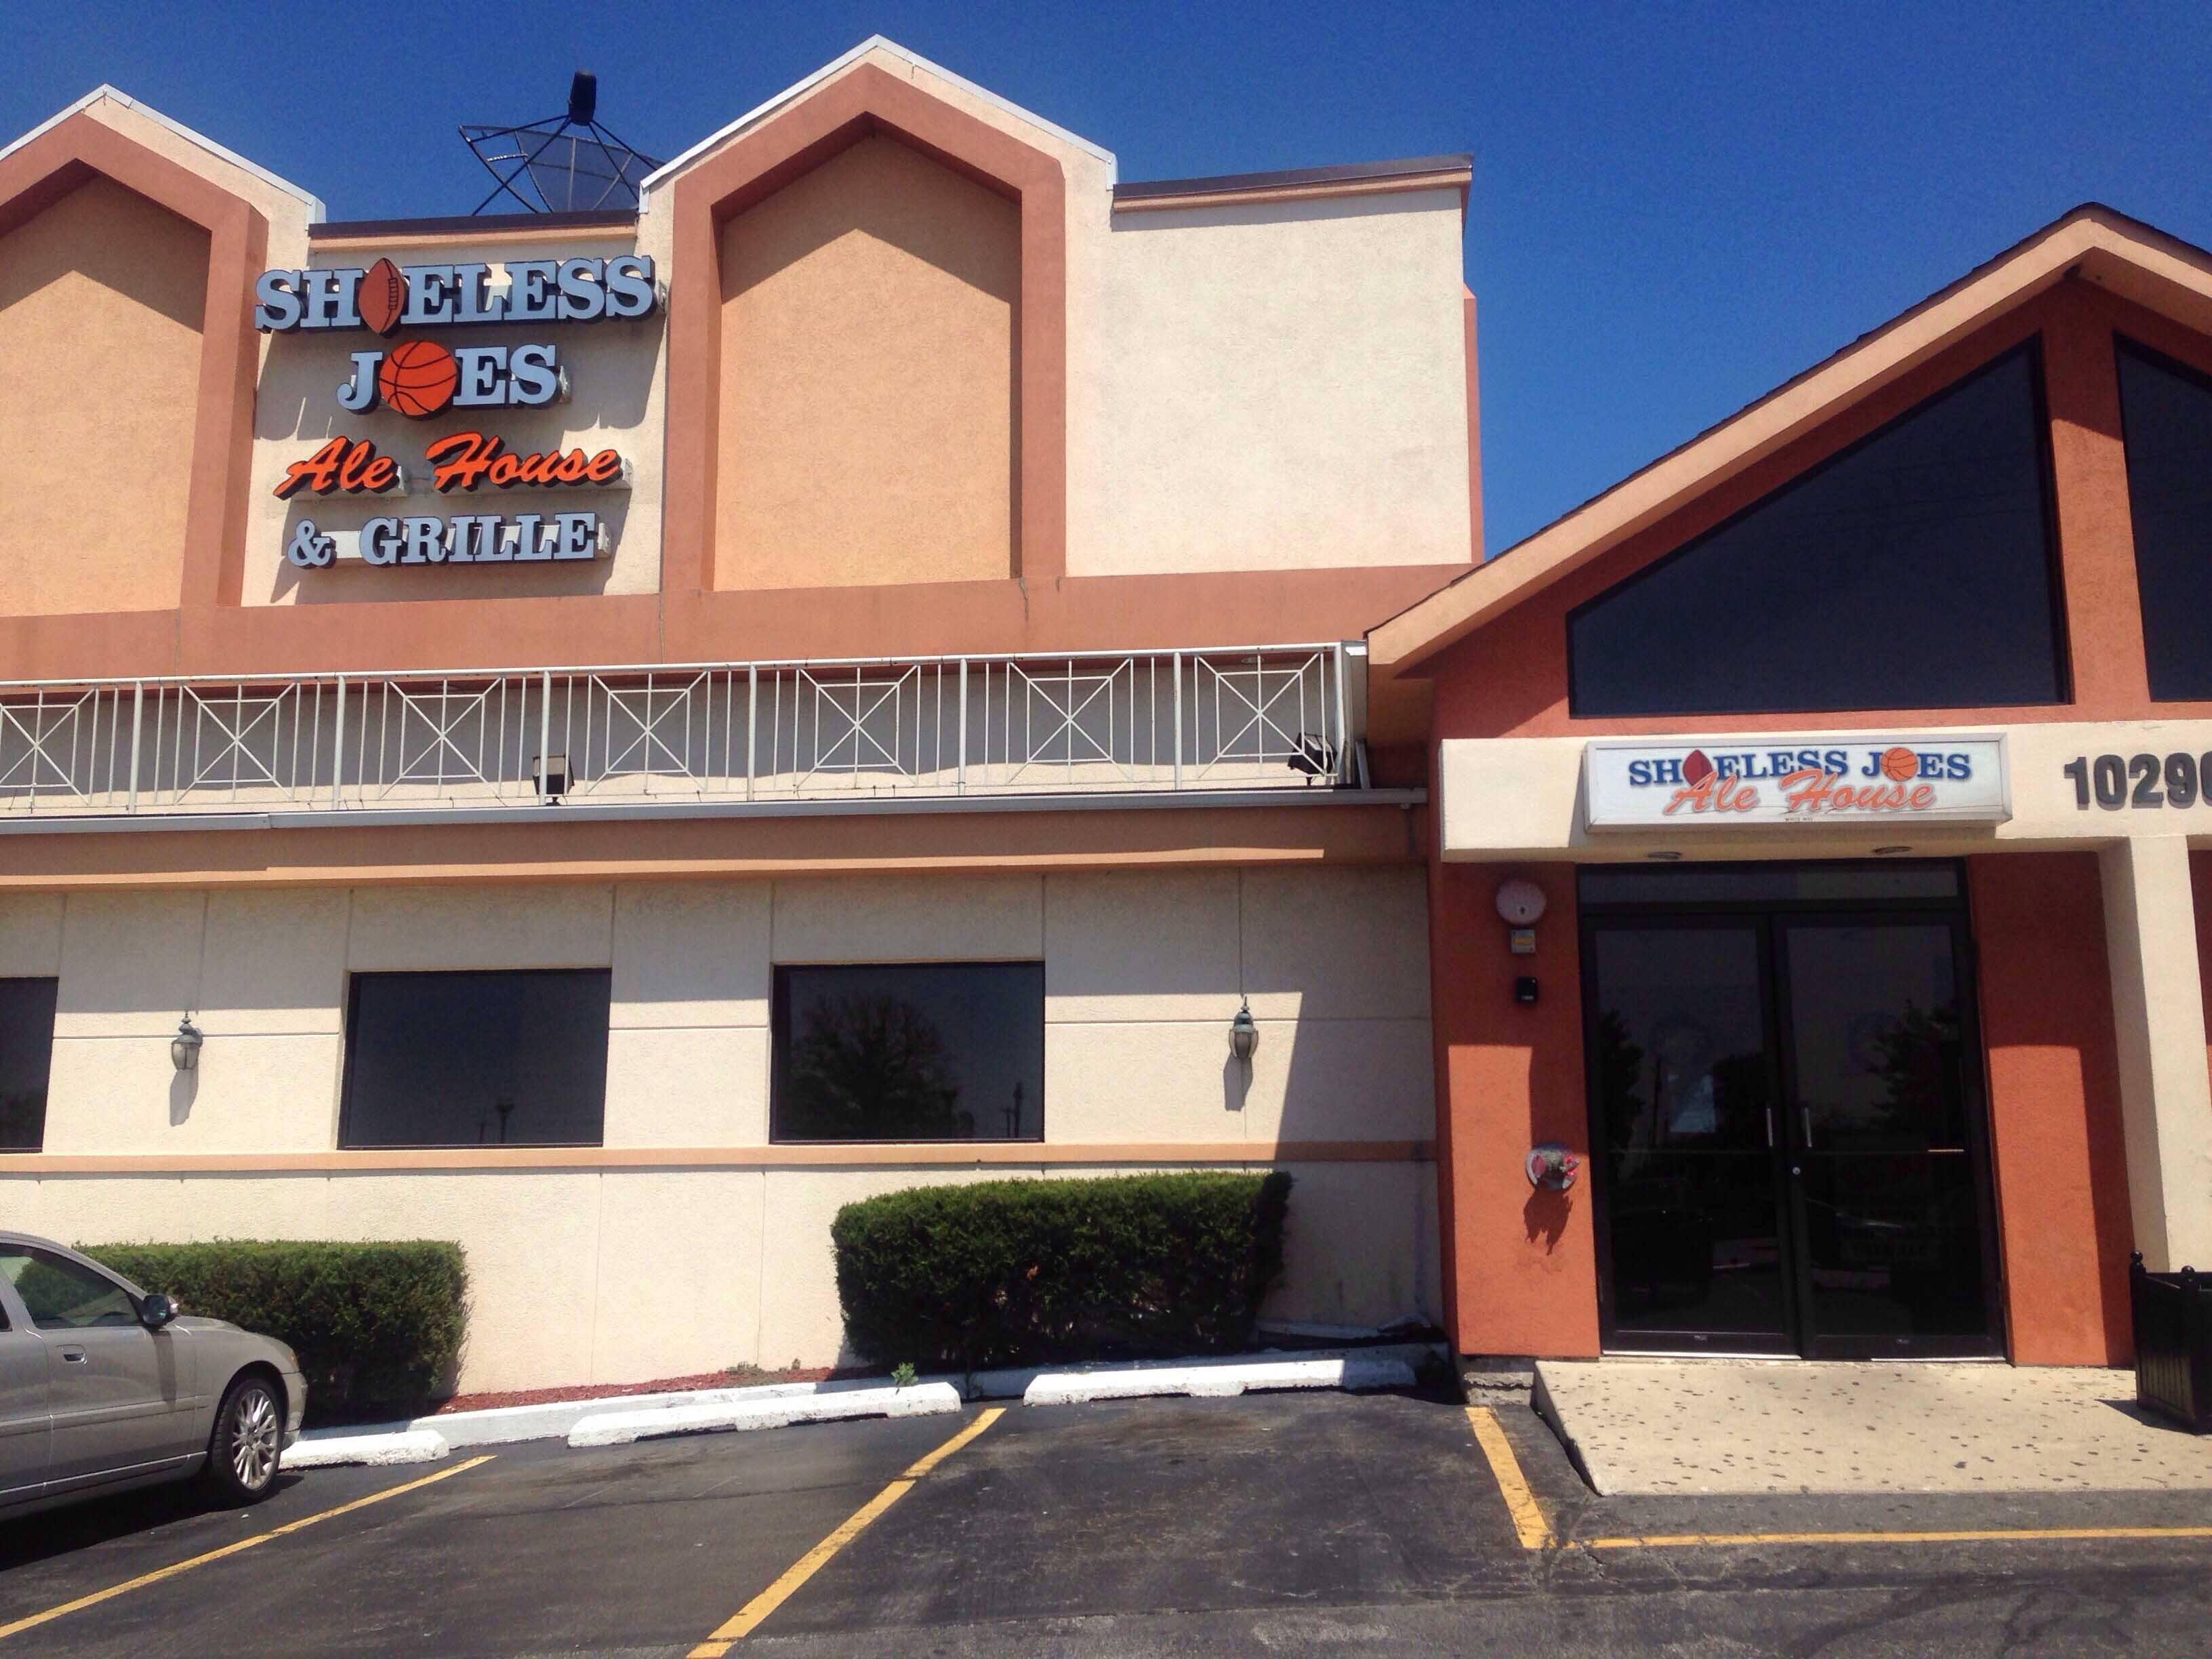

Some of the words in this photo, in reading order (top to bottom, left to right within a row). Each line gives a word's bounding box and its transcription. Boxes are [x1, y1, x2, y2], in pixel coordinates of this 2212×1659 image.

[272, 434, 396, 499] Ale
[425, 430, 623, 491] House
[287, 518, 332, 567] &
[359, 512, 597, 565] GRILLE
[1662, 771, 1759, 815] Ale
[1778, 768, 1936, 811] House
